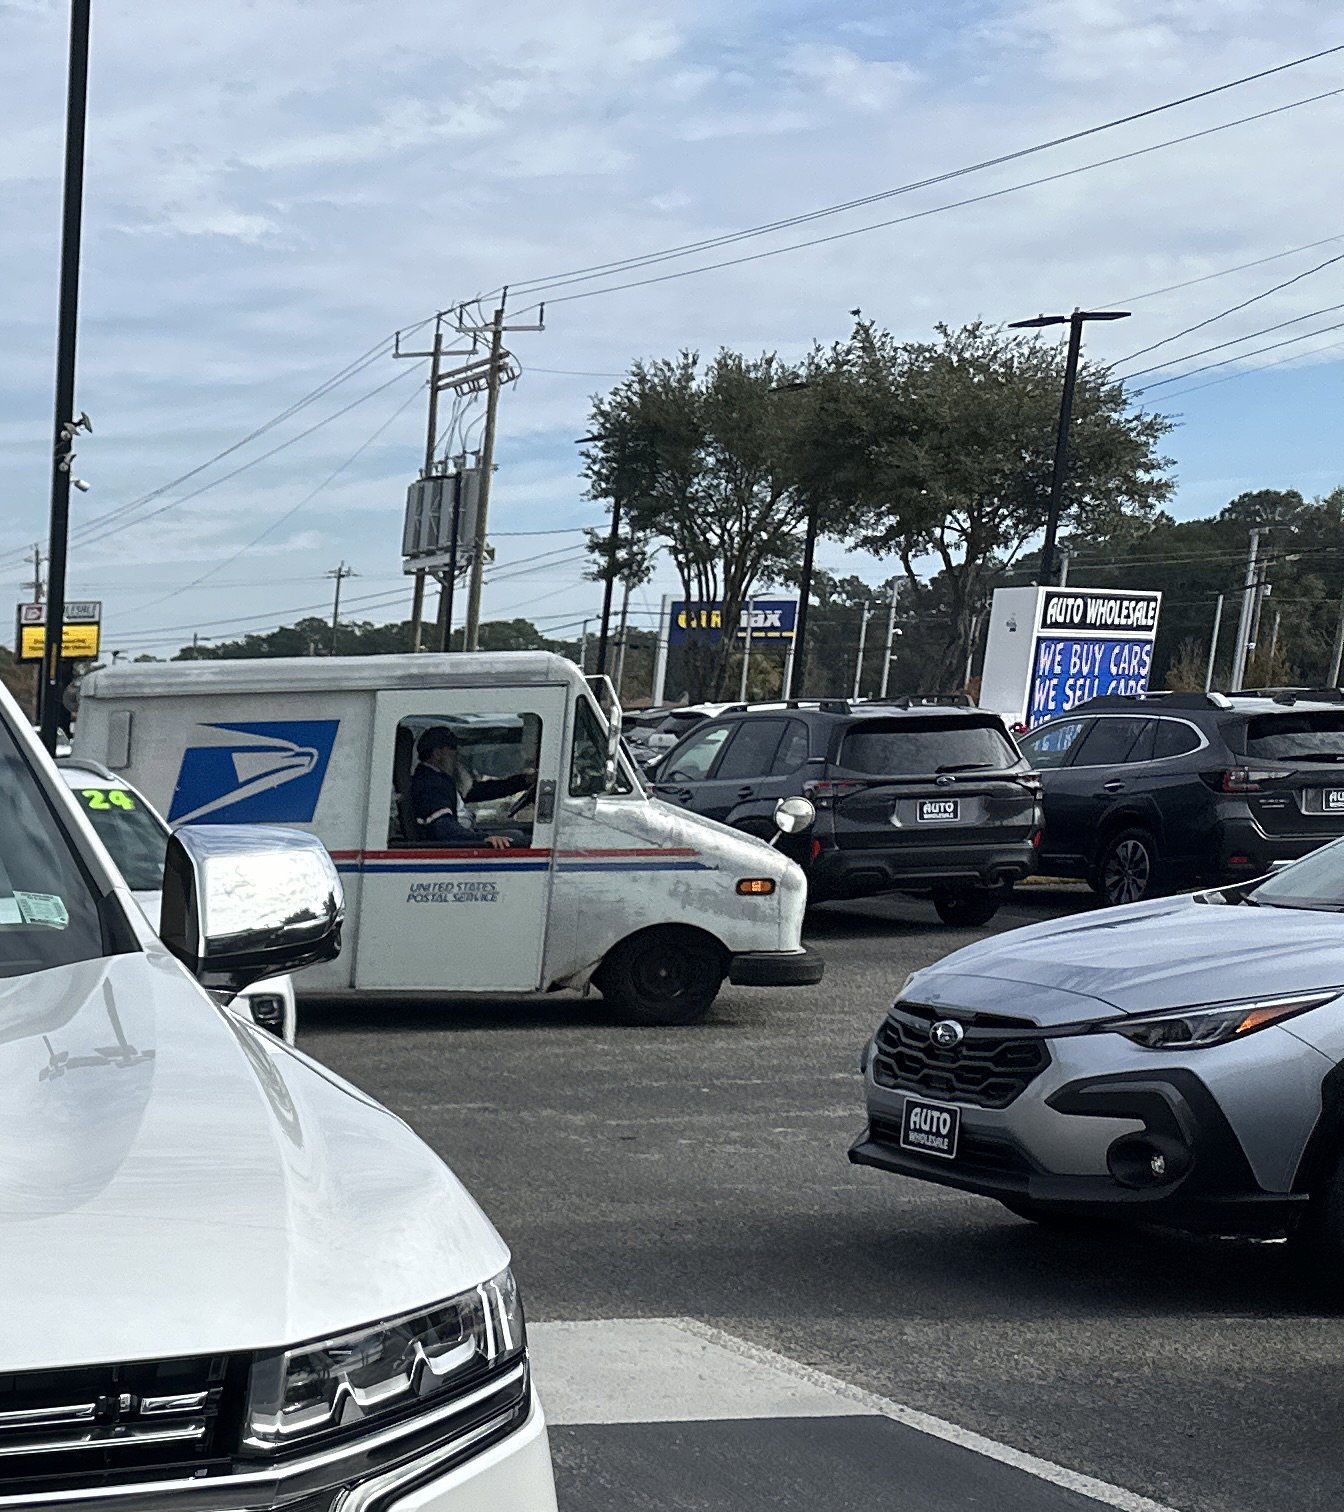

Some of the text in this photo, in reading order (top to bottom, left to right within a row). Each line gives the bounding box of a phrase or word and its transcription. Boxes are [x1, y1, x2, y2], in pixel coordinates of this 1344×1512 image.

[1046, 597, 1084, 625] AUTO
[1085, 597, 1157, 628] WHOLESALE
[1038, 642, 1152, 677] WE BUY CARS
[1033, 678, 1060, 712] WE
[1062, 678, 1100, 711] SELL
[81, 789, 136, 810] 24
[923, 802, 954, 813] AUTO
[406, 892, 499, 903] POSTAL SERVICE
[410, 881, 497, 893] UNITED STATES
[910, 1107, 951, 1135] AUTO
[908, 1130, 949, 1150] WHOLESALE
